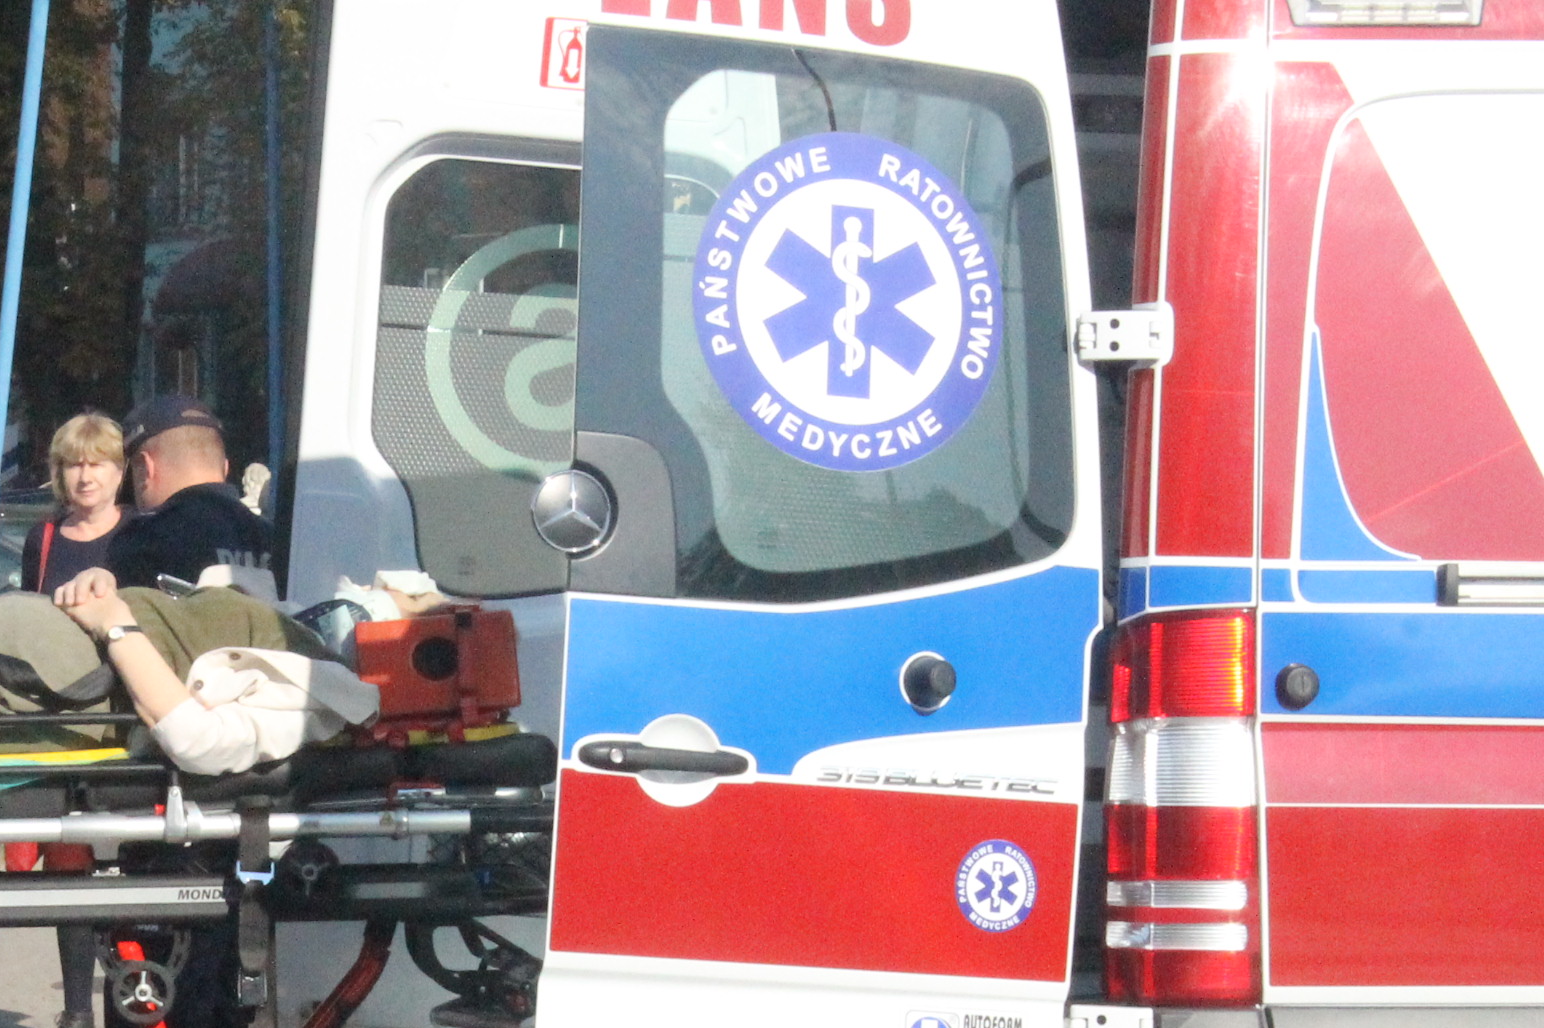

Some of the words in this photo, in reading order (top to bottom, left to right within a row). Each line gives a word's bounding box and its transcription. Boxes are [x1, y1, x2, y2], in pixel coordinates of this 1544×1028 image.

[700, 145, 831, 356] PAŃSTWOWE
[878, 153, 993, 380] RATOWNICTWO
[750, 392, 943, 460] MEDYCZNE
[177, 888, 223, 901] MOND
[968, 911, 1021, 931] MEDYCZNE
